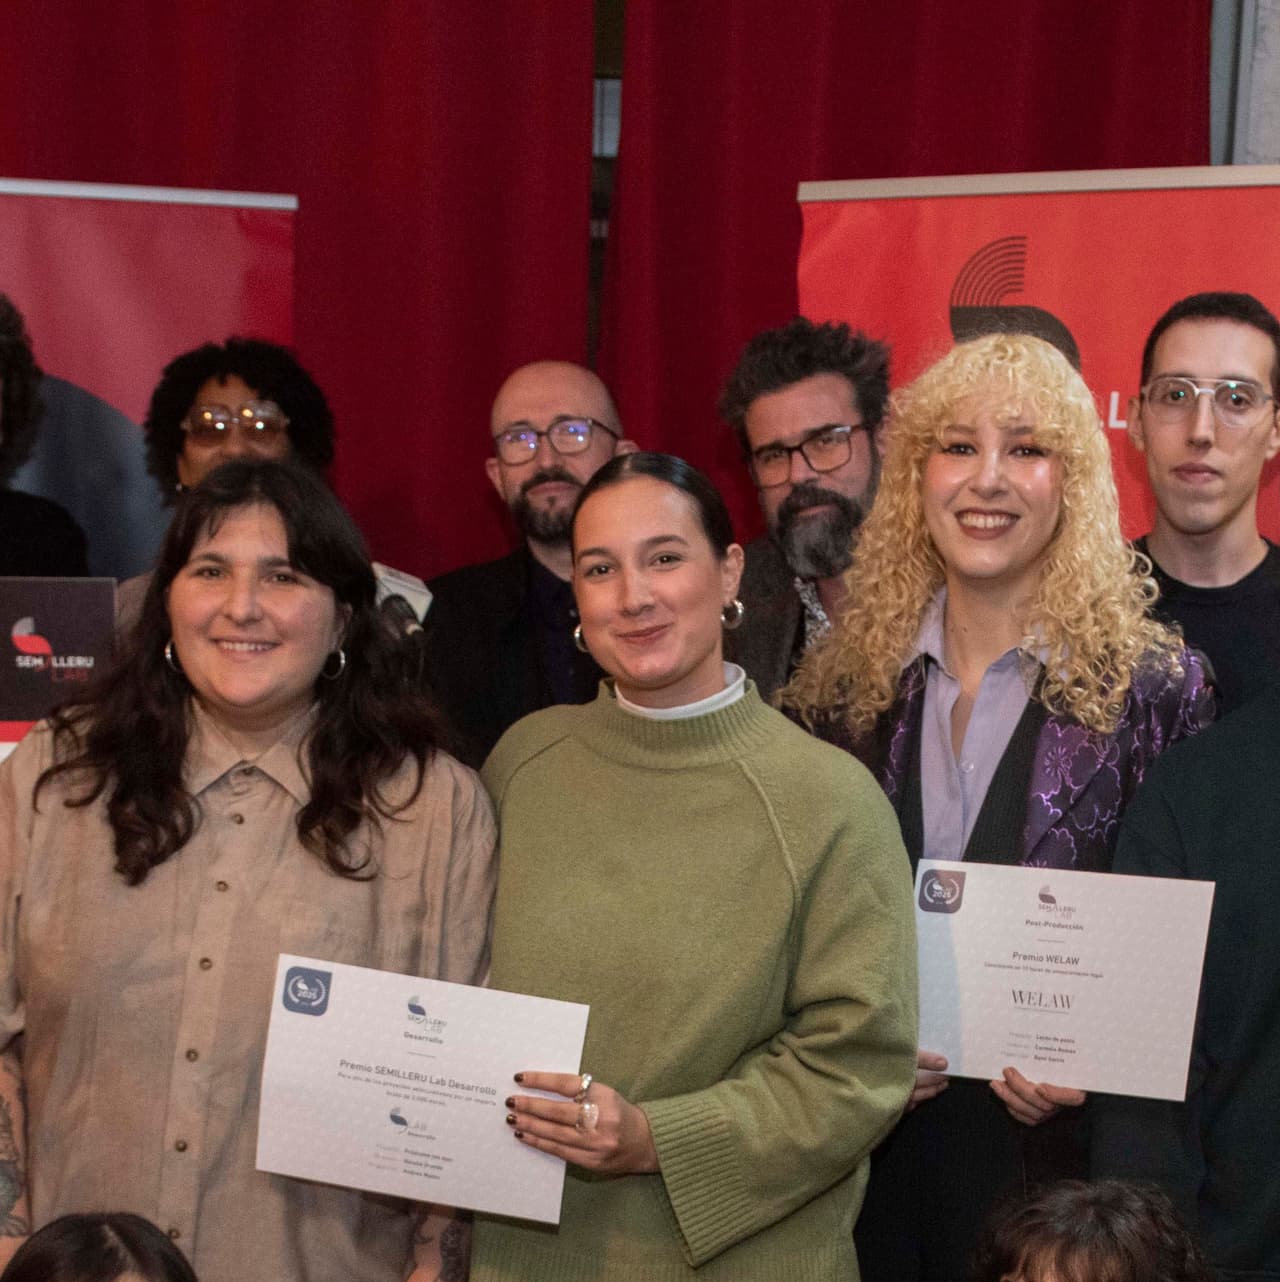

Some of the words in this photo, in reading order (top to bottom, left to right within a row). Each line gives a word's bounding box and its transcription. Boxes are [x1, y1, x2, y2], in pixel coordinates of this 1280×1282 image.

[1012, 951, 1044, 963] Premio
[1046, 954, 1080, 965] WELAW
[1012, 989, 1076, 1009] WELAW
[339, 1059, 373, 1073] Premio
[374, 1065, 428, 1083] SEMILLERU
[429, 1076, 447, 1087] Lab
[448, 1079, 497, 1096] Desarrollo
